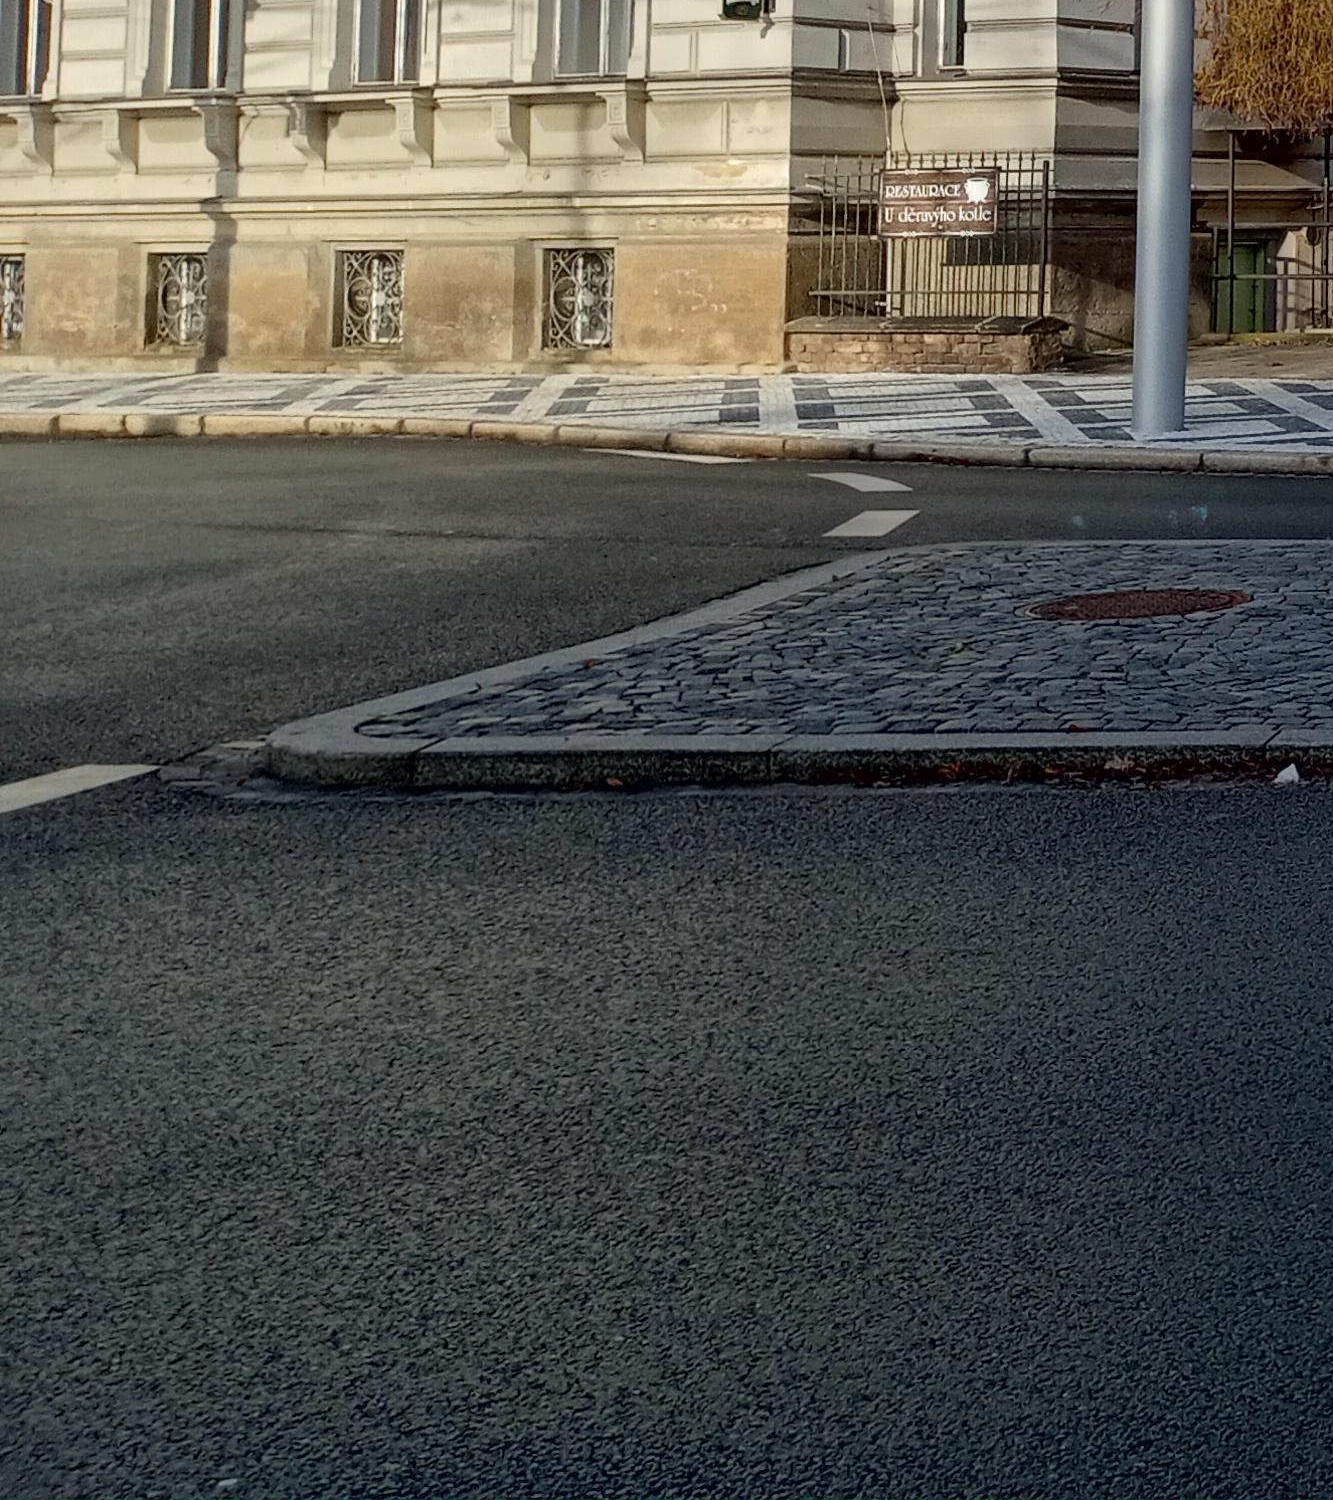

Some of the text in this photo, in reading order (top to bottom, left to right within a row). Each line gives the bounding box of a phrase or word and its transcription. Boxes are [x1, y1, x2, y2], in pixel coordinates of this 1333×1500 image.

[885, 184, 961, 199] RESTAURACE
[884, 206, 894, 222] U
[958, 204, 993, 221] kotle
